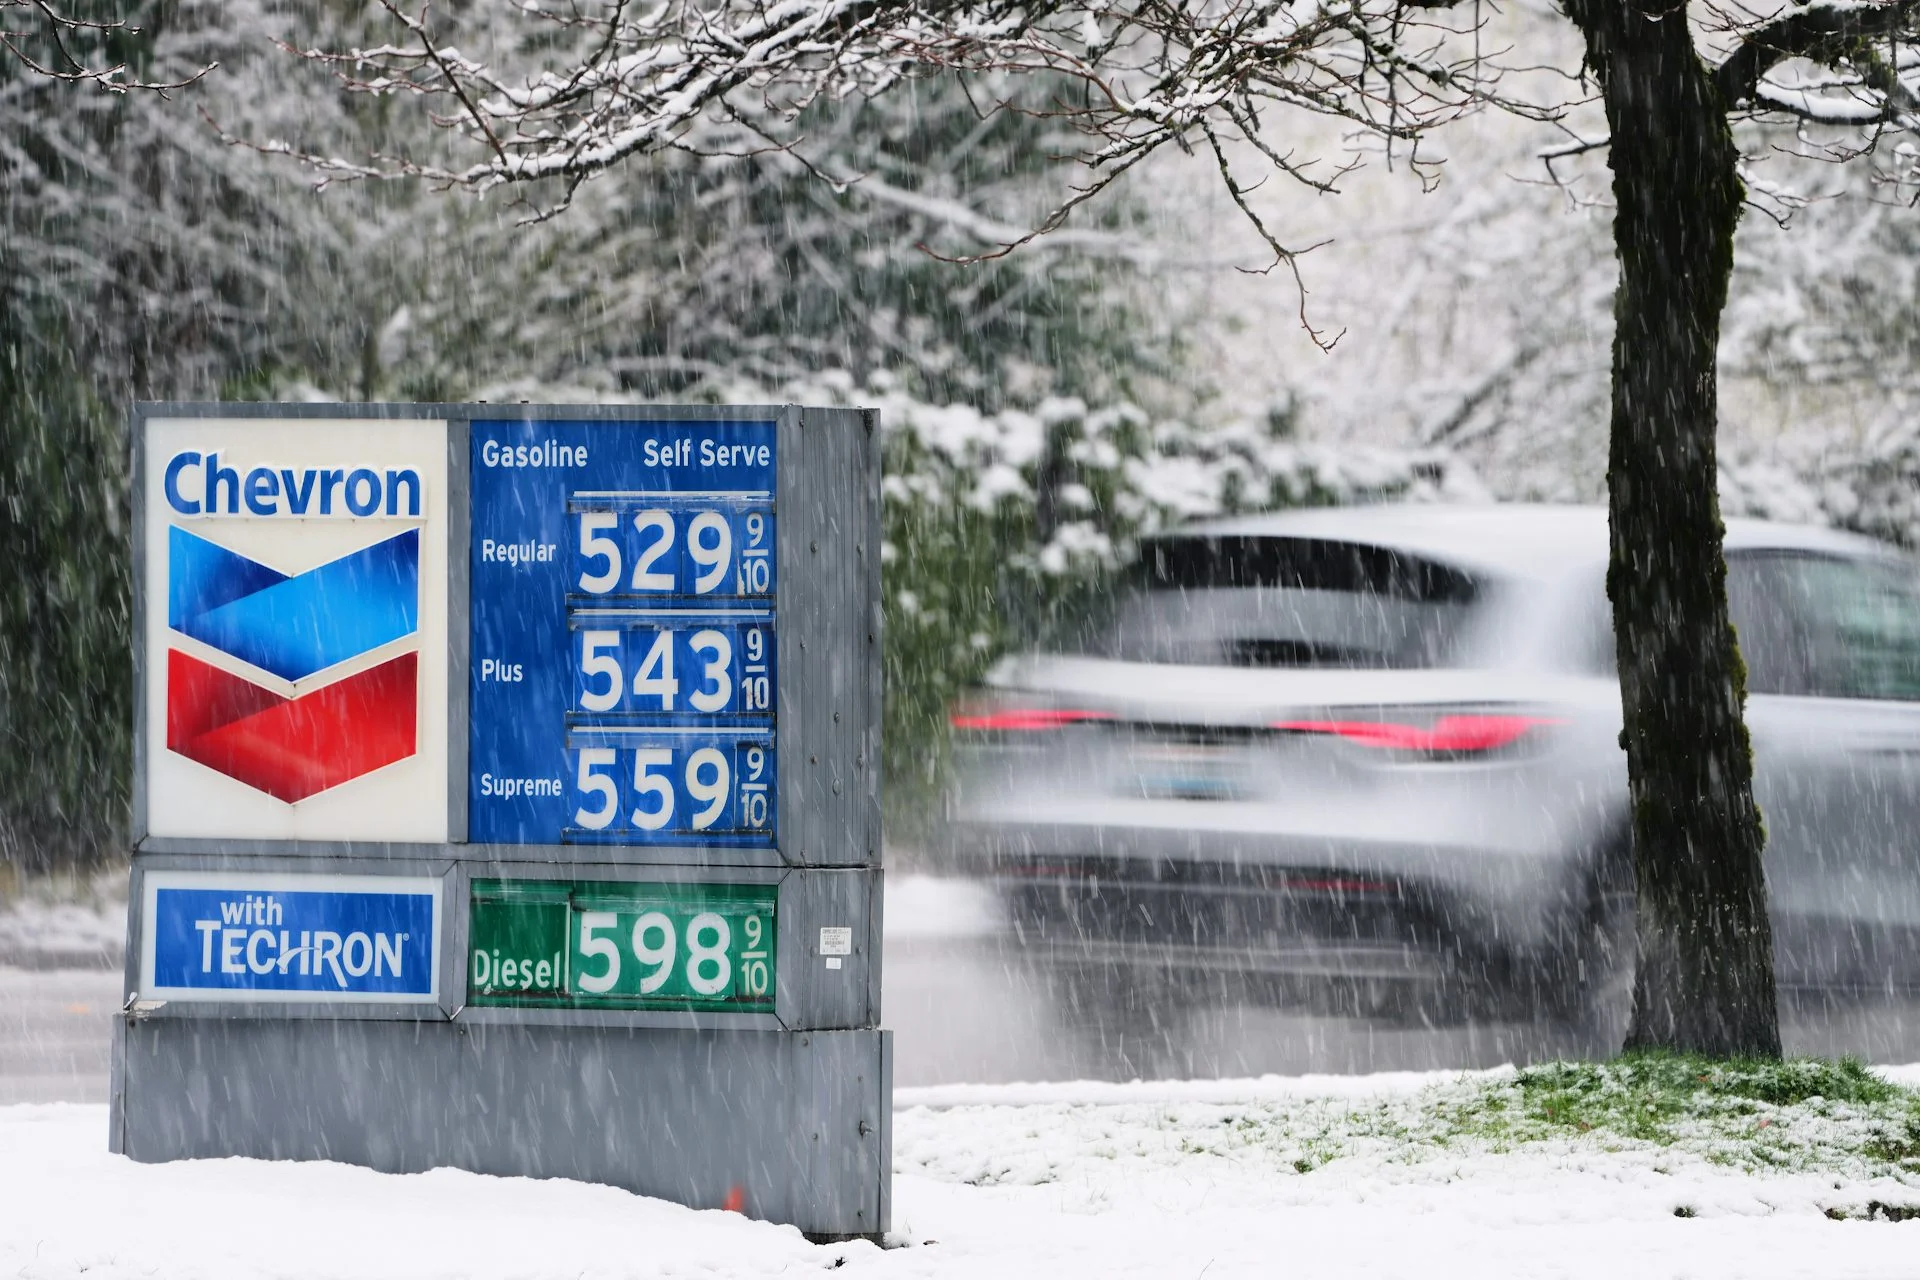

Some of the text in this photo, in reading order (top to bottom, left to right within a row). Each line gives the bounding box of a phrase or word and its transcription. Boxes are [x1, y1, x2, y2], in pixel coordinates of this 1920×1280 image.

[482, 439, 588, 468] Gasoline
[643, 438, 770, 467] Self Serve
[164, 451, 420, 517] Chevron
[482, 539, 556, 567] Regular
[578, 509, 732, 594] 529
[481, 659, 523, 682] Plus
[580, 630, 732, 712] 543
[481, 773, 562, 800] Supreme
[574, 748, 730, 830] 559
[220, 895, 283, 926] with
[474, 949, 560, 989] Diesel
[578, 911, 732, 995] 598
